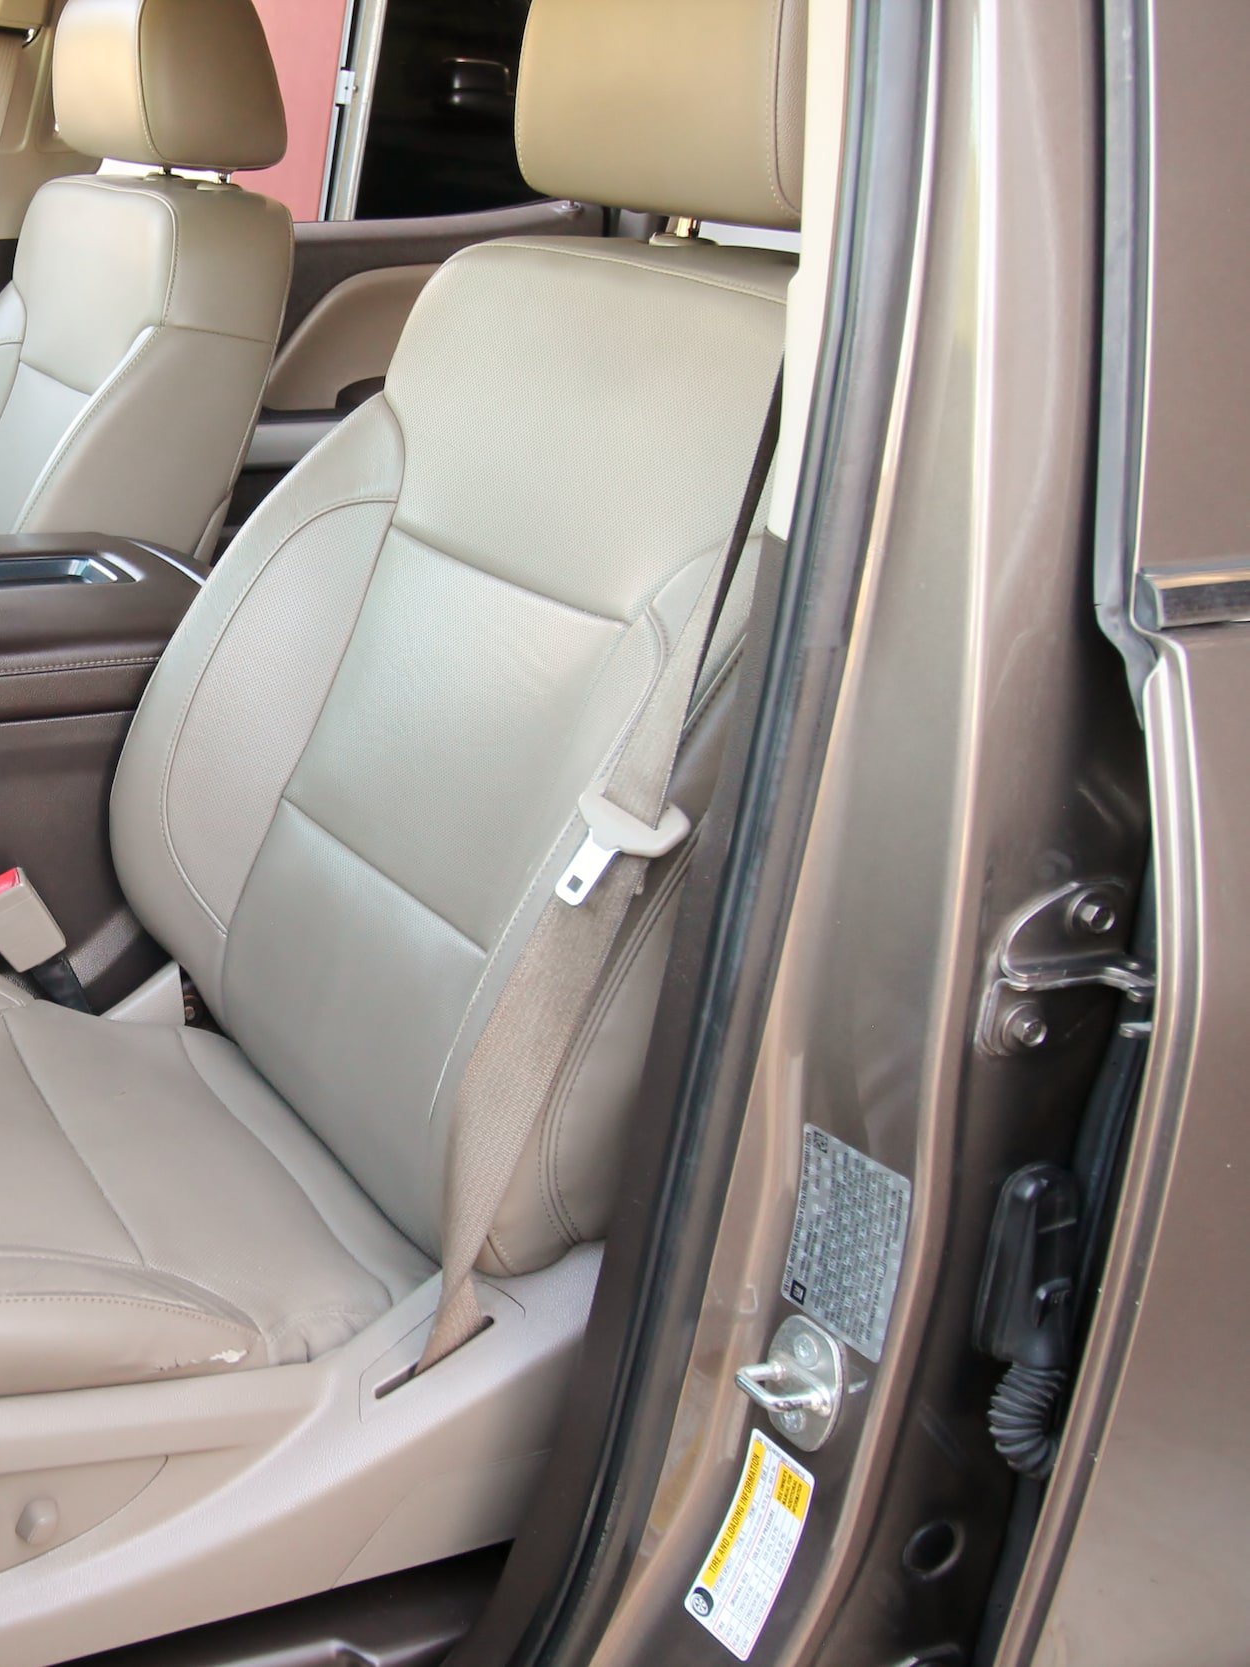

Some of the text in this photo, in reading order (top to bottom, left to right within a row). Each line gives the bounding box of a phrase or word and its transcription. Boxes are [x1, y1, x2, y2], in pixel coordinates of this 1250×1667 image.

[800, 1179, 808, 1208] CONTROL
[782, 1485, 790, 1505] MANUAL
[787, 1479, 797, 1509] ADDITIONAL
[792, 1483, 802, 1513] INFORMATION
[709, 1453, 759, 1573] TIRE AND LOADING INFORMATION
